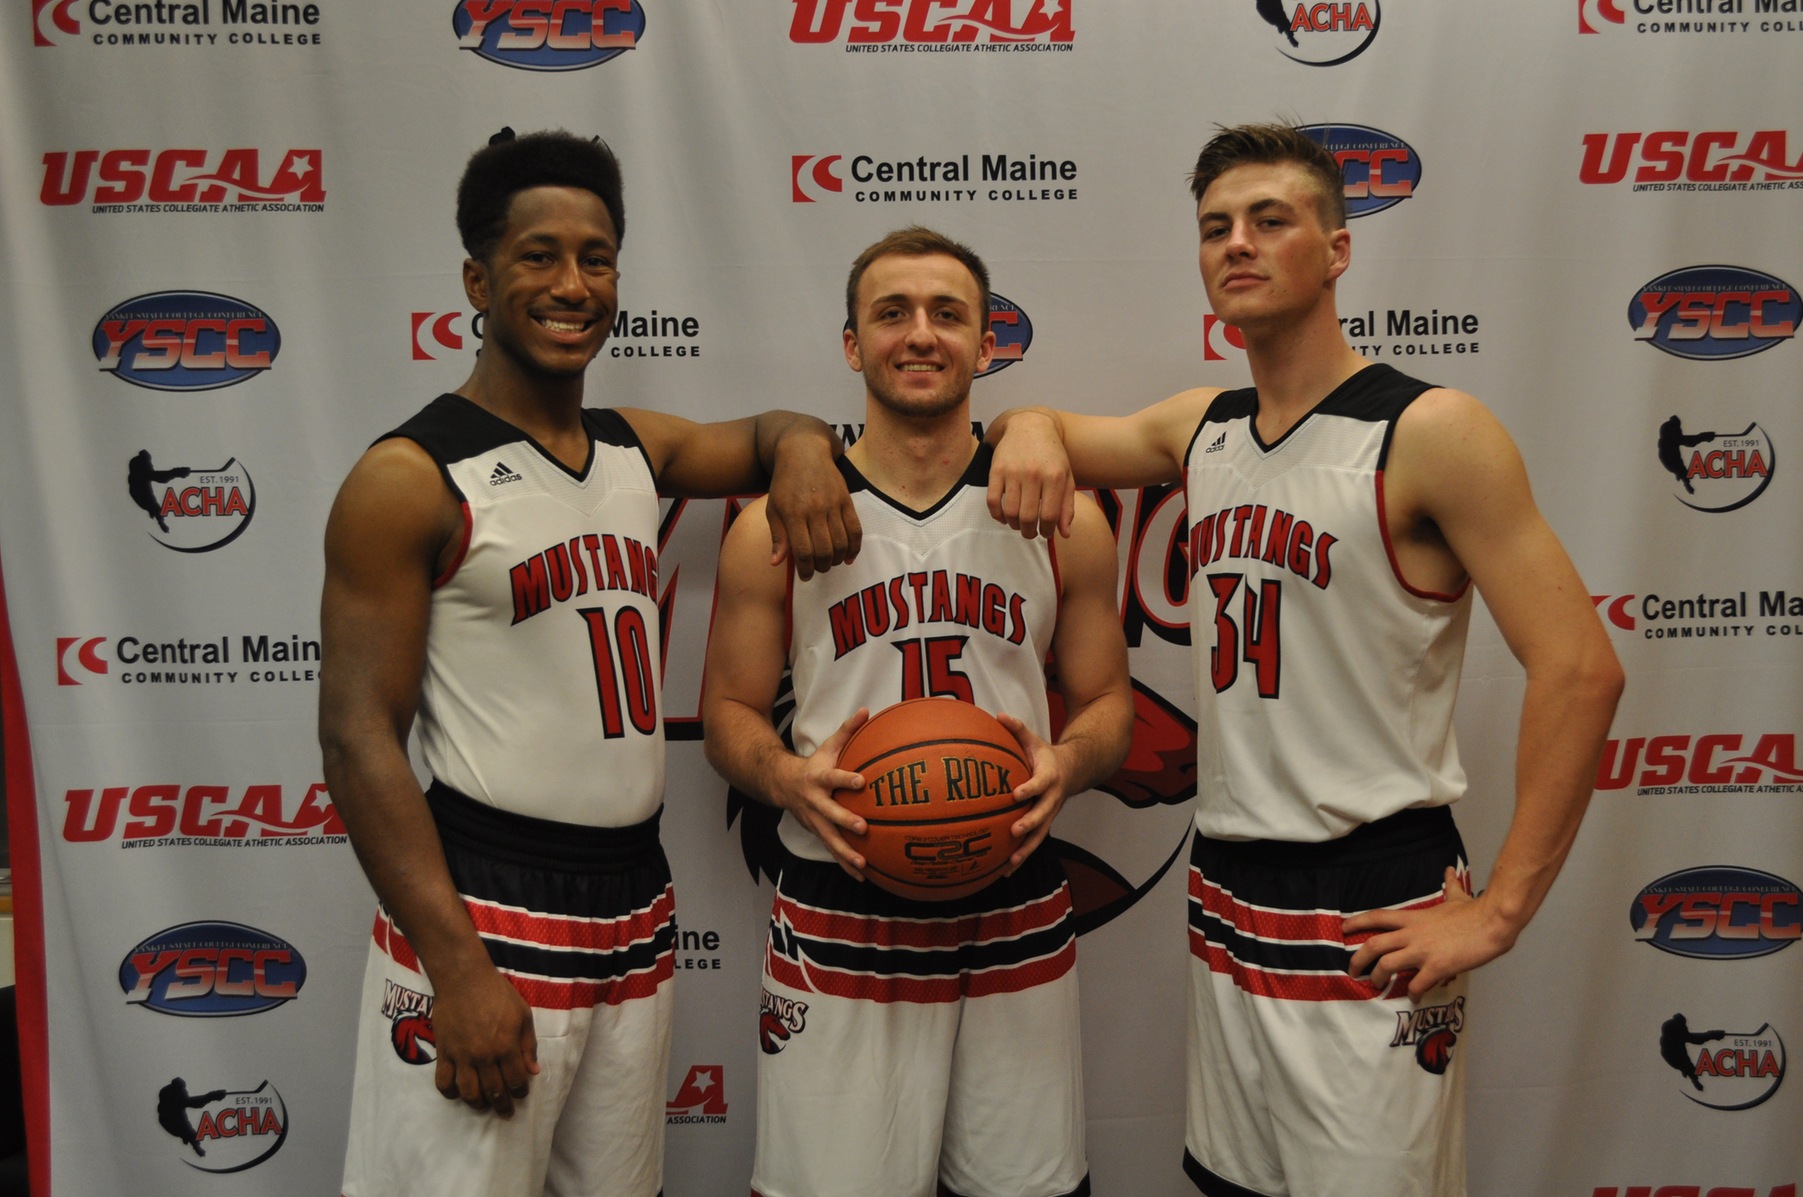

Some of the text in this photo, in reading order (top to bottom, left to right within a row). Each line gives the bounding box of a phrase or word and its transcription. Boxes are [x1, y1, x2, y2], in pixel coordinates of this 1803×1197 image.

[88, 0, 320, 25] Central Maine
[459, 0, 636, 50] YSCC
[789, 0, 1076, 43] USCAA
[1290, 3, 1374, 32] ACHA
[93, 33, 321, 45] COMMUNITY COLLEGE
[1637, 22, 1750, 33] COMMUNITY
[846, 44, 1074, 53] UNITED STATES COLLEGIATE ATHETIC ASSOCIATION
[852, 154, 1078, 182] Central Maine
[1579, 130, 1803, 184] USCA
[40, 149, 326, 206] USCAA
[1632, 184, 1664, 192] UNITED
[1666, 183, 1696, 192] STATES
[1698, 183, 1747, 191] COLLEGIATE
[1748, 182, 1786, 191] ATHETIC
[92, 203, 325, 214] UNITED STATES COLLEGIATE ATHETIC ASSOCIATION
[856, 189, 1078, 202] COMMUNITY COLLEGE
[608, 310, 699, 338] Maine
[1387, 309, 1479, 336] Maine
[1634, 290, 1794, 341] YSCC
[100, 318, 272, 371] YSCC
[610, 346, 700, 358] COLLEGE
[1393, 342, 1480, 355] COLLEGE
[1686, 450, 1768, 479] ACHA
[160, 486, 249, 517] ACHA
[509, 534, 658, 626] MUSTANG
[828, 569, 1027, 662] MUSTANGS
[1642, 592, 1746, 620] Central
[1206, 573, 1281, 700] 34
[1645, 626, 1754, 639] COMMUNITY
[116, 634, 321, 664] Central Main
[122, 670, 321, 684] COMMUNITY COLLE
[576, 605, 656, 740] 10
[890, 635, 975, 706] 15
[1594, 734, 1803, 790] USCA
[869, 757, 1013, 806] THE ROCK
[1637, 787, 1665, 796] UNITED
[1666, 786, 1699, 794] STATES
[1701, 785, 1754, 793] COLLEGIATE
[1756, 785, 1795, 793] ATHETIC
[63, 783, 348, 842] USCAA
[122, 836, 347, 850] UNITED STATES COLLEGIATE ATHETIC ASSOCIATION
[1635, 892, 1802, 942] YSCC
[126, 948, 297, 1004] YSCC
[1695, 1048, 1780, 1078] ACHA
[196, 1107, 283, 1141] ACHA
[667, 1116, 726, 1124] ASSOCIATION
